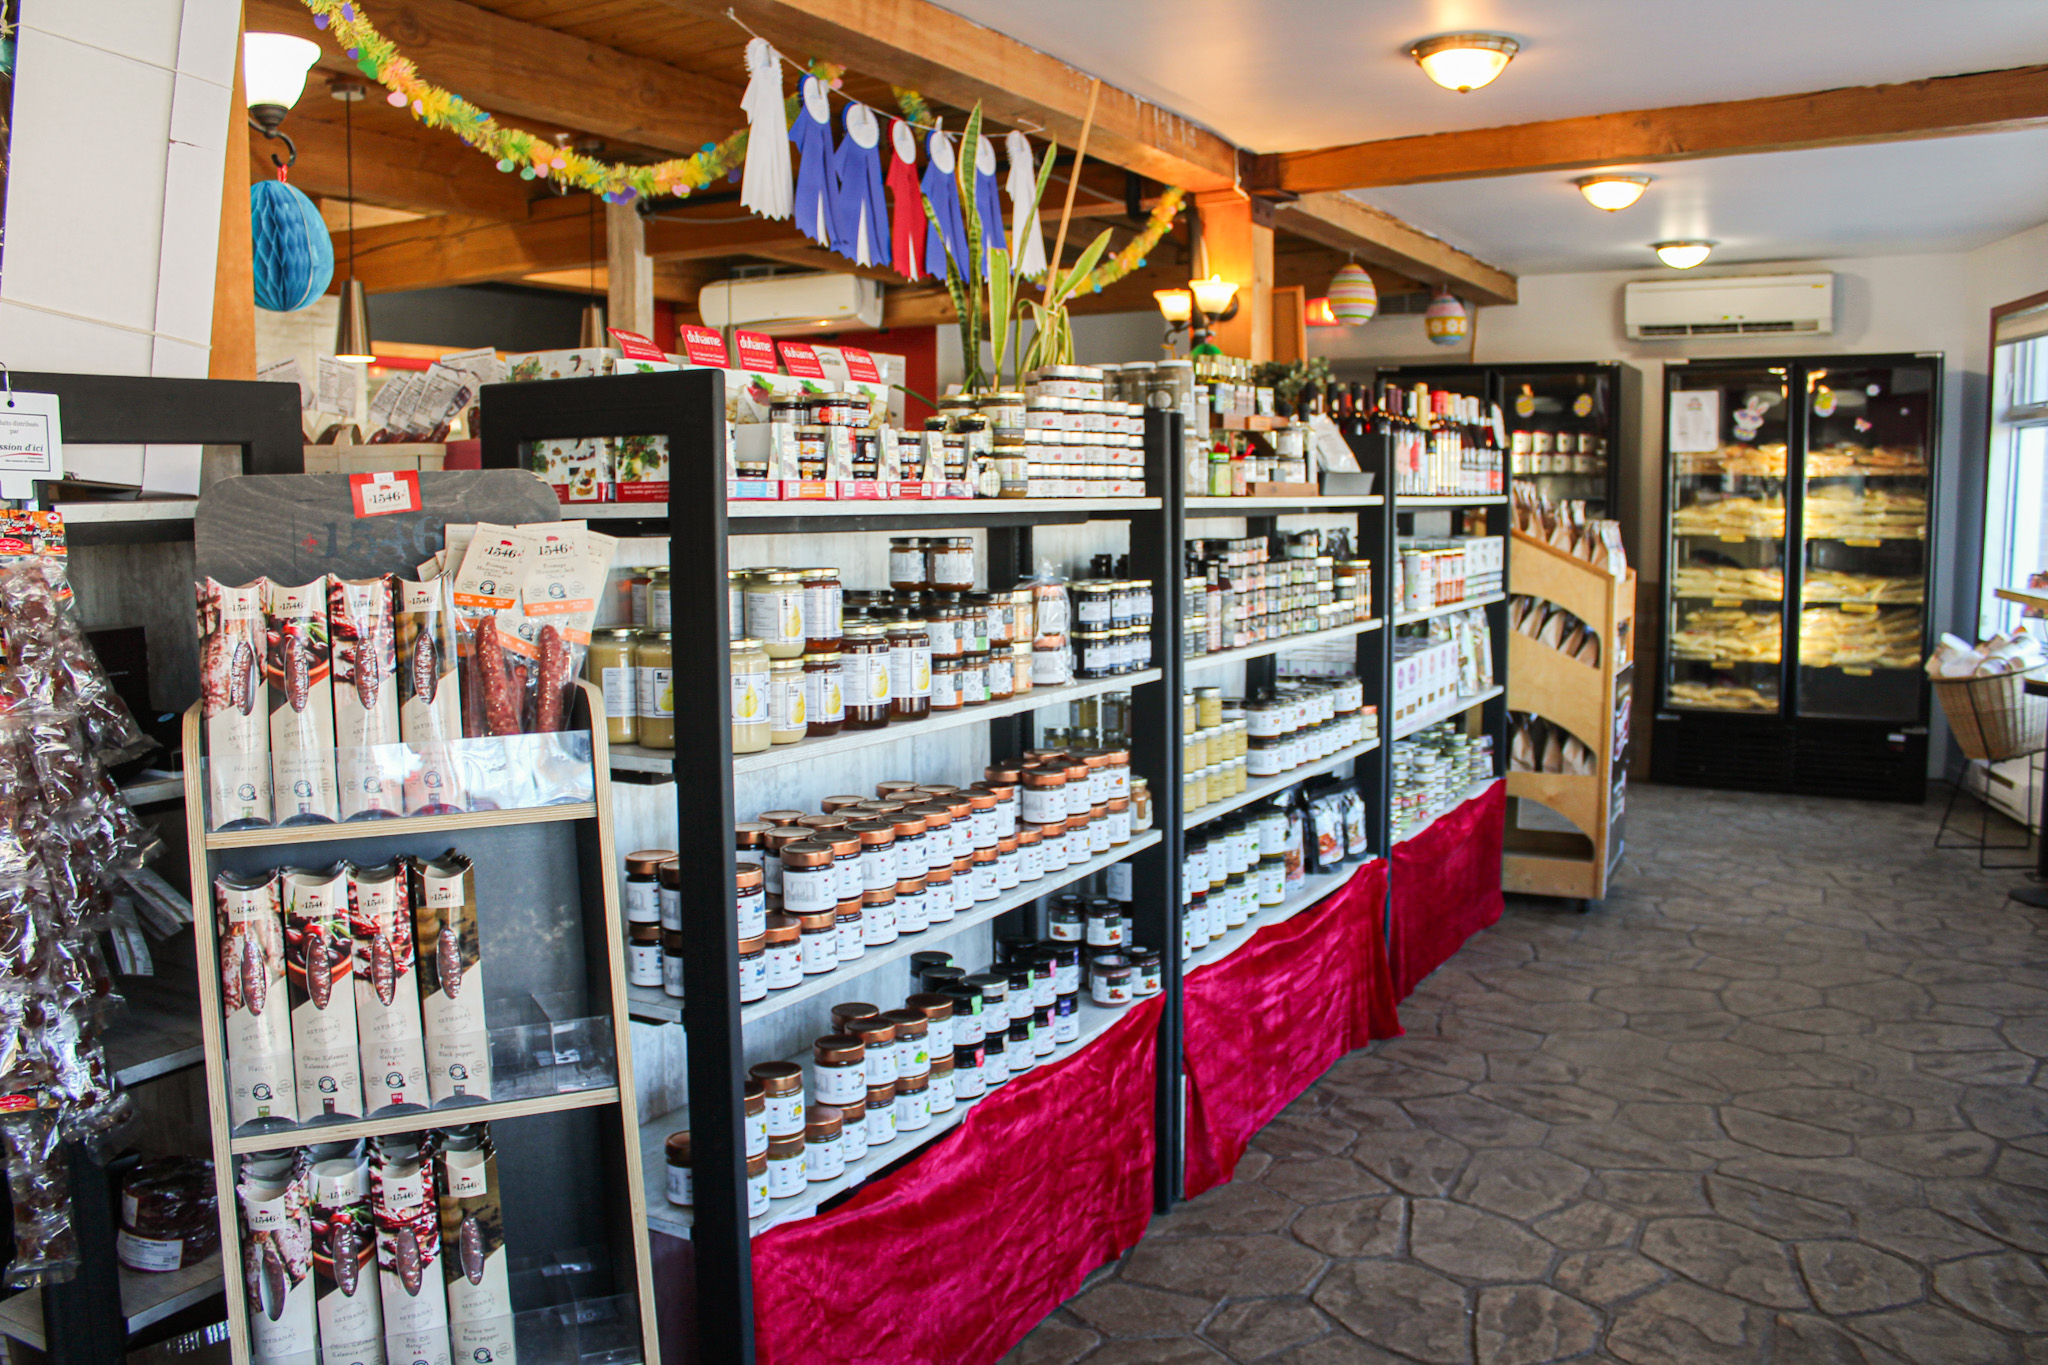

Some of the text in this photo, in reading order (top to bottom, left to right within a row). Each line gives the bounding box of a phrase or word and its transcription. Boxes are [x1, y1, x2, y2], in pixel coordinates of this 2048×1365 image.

[686, 330, 722, 346] duhaime
[740, 335, 772, 352] duhaime
[783, 346, 816, 361] duhaime
[372, 491, 401, 504] 1546
[488, 546, 518, 558] 1546
[538, 543, 568, 556] 1546
[282, 602, 303, 610] 1546
[434, 893, 455, 901] 1546
[366, 898, 387, 907] 1546
[456, 1181, 477, 1191] 1546
[330, 1190, 351, 1200] 156
[393, 1192, 414, 1201] 1546
[255, 1215, 276, 1224] 1546
